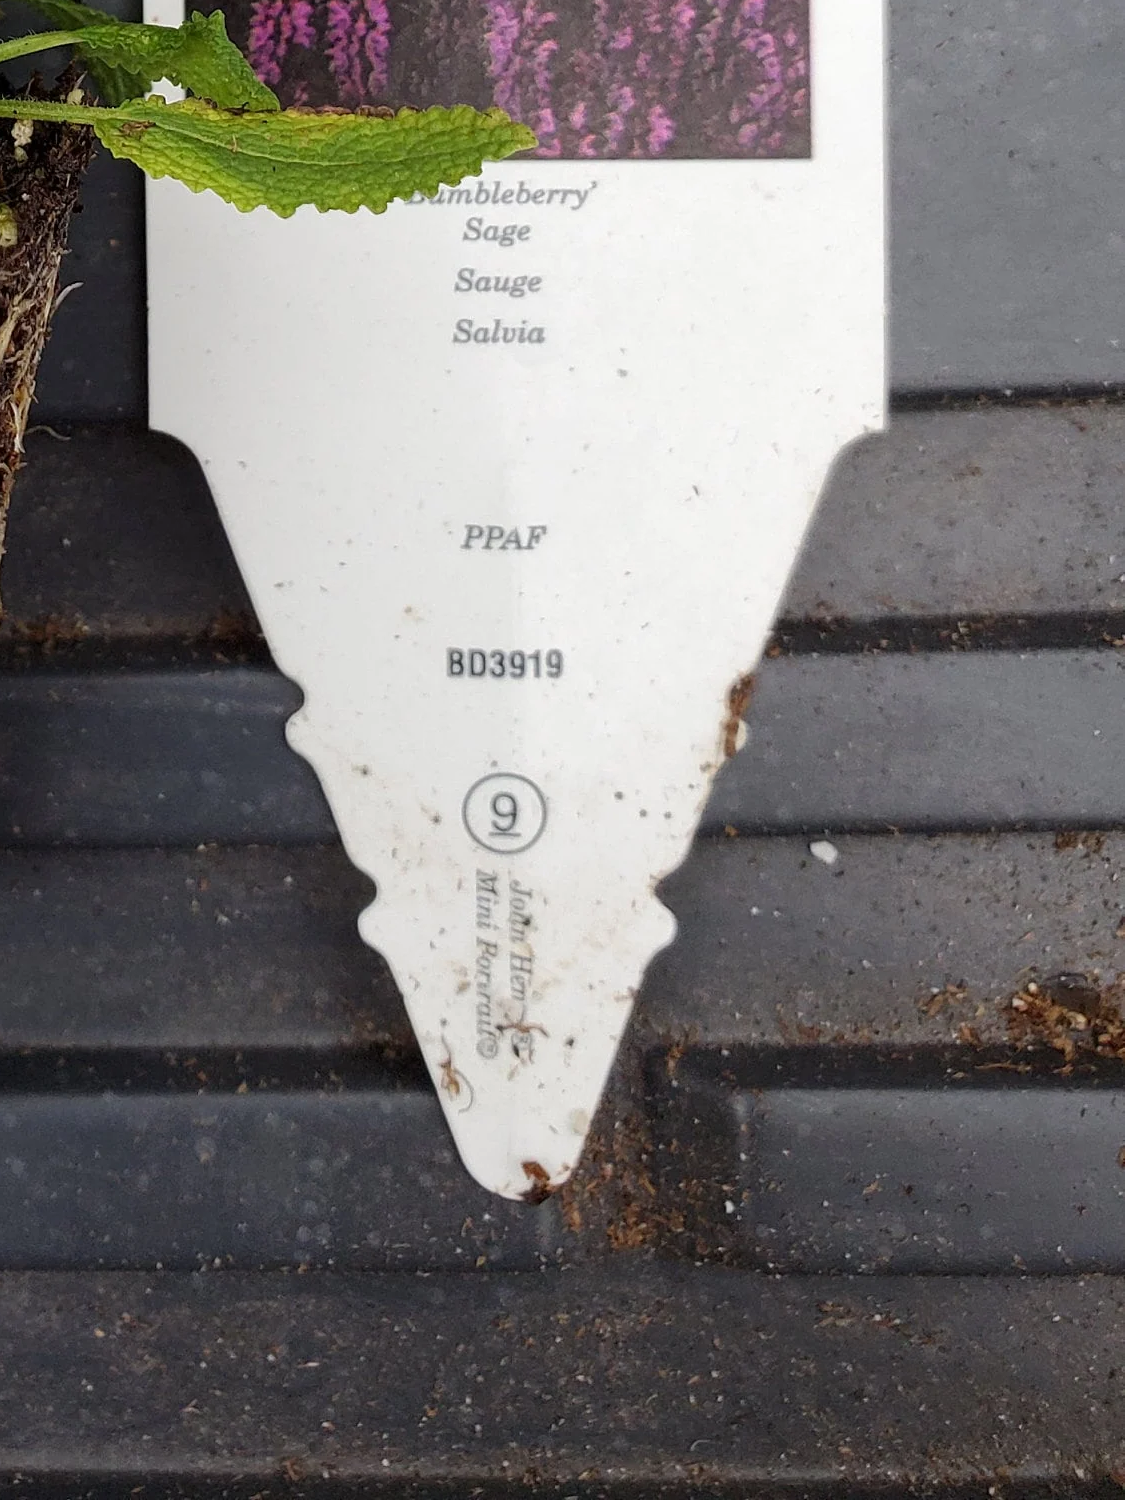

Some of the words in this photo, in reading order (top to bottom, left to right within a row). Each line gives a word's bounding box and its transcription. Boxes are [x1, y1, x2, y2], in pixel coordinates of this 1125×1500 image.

[462, 217, 531, 247] Sage
[454, 268, 543, 298] Sauge
[452, 318, 546, 345] Salvia
[460, 524, 548, 551] PPAF
[446, 647, 564, 679] BD3919
[488, 790, 522, 836] 9
[475, 868, 500, 930] Mini
[509, 878, 534, 944] John
